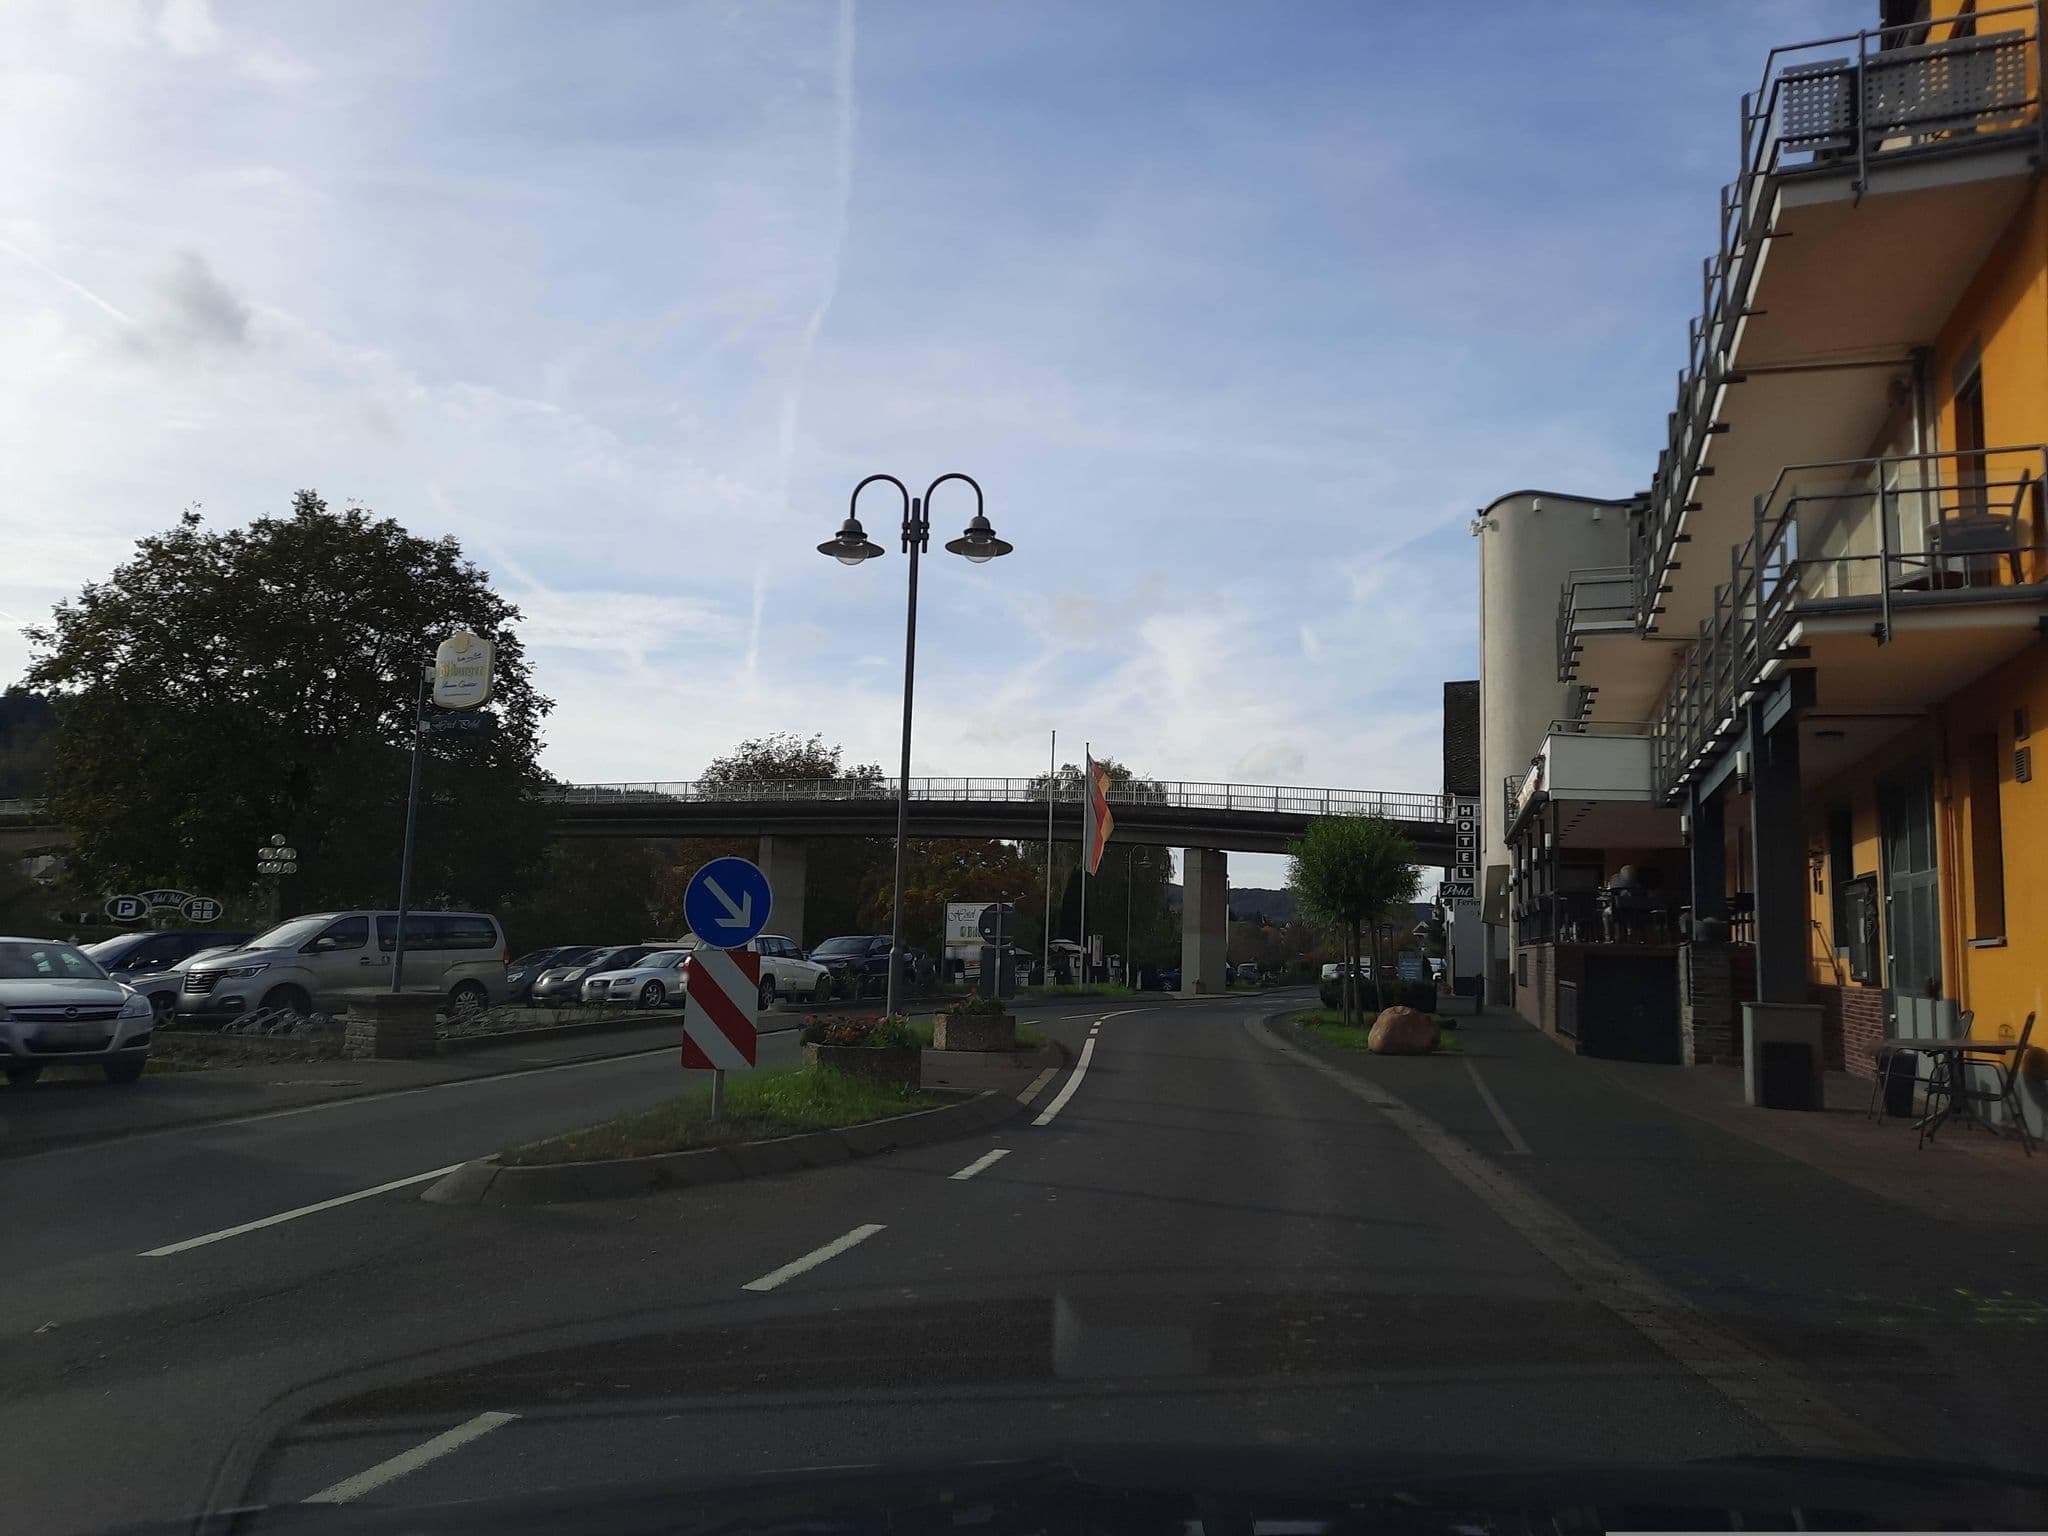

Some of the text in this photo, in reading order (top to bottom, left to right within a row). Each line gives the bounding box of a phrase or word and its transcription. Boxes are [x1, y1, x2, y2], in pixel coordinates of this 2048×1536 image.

[1459, 805, 1472, 878] HOTEL
[1441, 883, 1474, 897] Pohl
[121, 902, 133, 913] P
